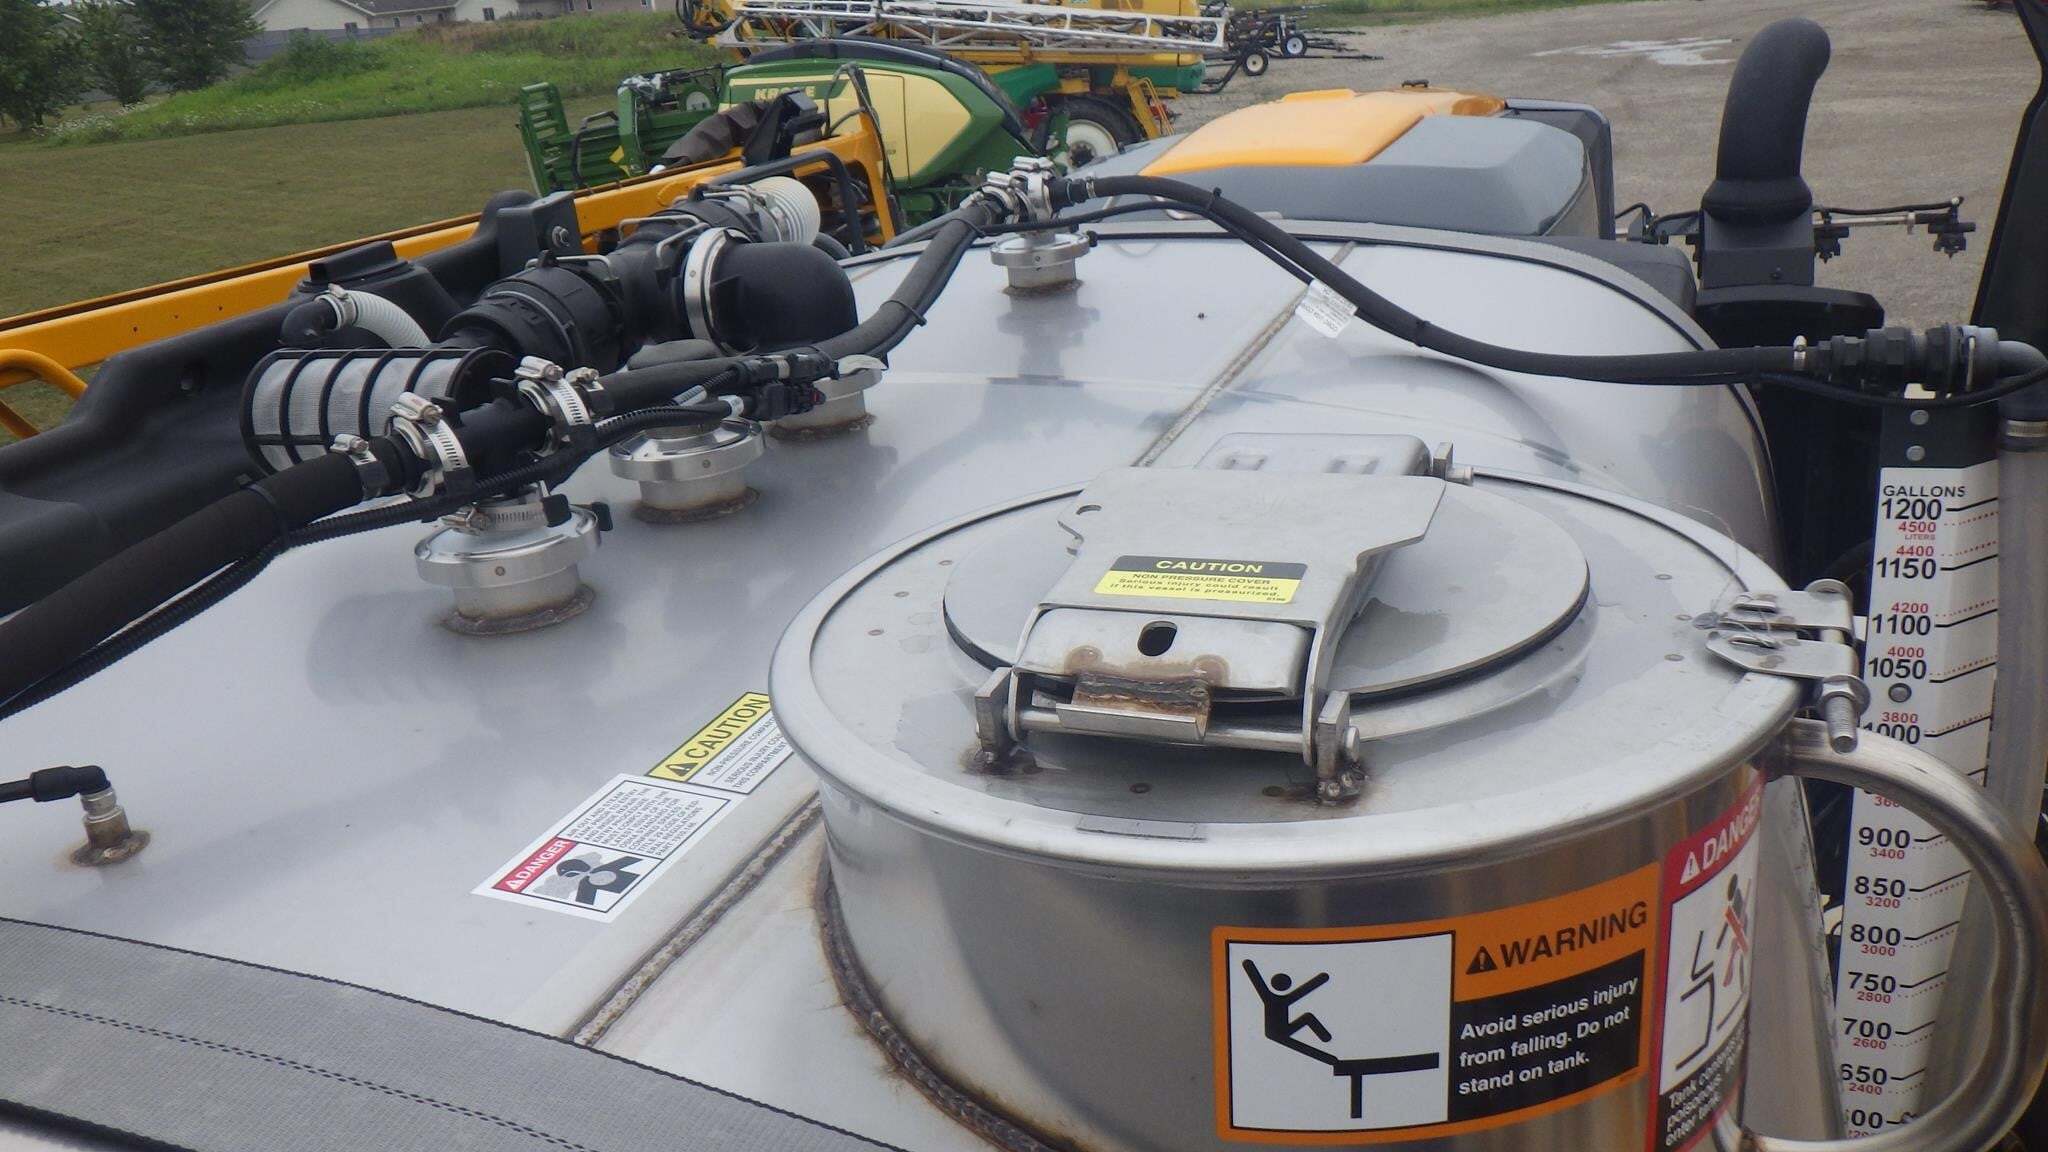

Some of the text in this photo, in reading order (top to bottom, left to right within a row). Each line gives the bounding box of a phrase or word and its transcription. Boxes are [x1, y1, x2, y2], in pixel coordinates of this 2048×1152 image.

[1883, 485, 1966, 498] GALLONS
[1881, 498, 1942, 520] 1200
[1898, 521, 1936, 533] 4500
[1896, 546, 1934, 557] 4400
[1155, 560, 1262, 574] CAUTION
[1876, 558, 1936, 580] 1150
[1891, 602, 1928, 614] 4200
[1871, 614, 1931, 636] 1100
[1887, 647, 1924, 658] 4000
[1868, 658, 1927, 680] 1050
[1882, 712, 1918, 723] 3800
[685, 698, 770, 760] CAUTION
[1858, 826, 1910, 849] 900
[516, 840, 572, 883] DANGER
[1870, 848, 1905, 860] 3400
[1854, 876, 1906, 898] 850
[1865, 896, 1900, 909] 3200
[1500, 901, 1647, 968] WARNING
[1850, 924, 1900, 946] 800
[1861, 944, 1896, 956] 3000
[1848, 972, 1896, 994] 750
[1460, 977, 1638, 1040] Avoid serious injury
[1856, 991, 1891, 1004] 2800
[1460, 1006, 1630, 1068] from falling. Do not
[1842, 1018, 1892, 1040] 700
[1852, 1038, 1886, 1050] 2600
[1459, 1051, 1590, 1095] stand on tank.
[1840, 1064, 1887, 1085] 650
[1849, 1083, 1882, 1095] 2400
